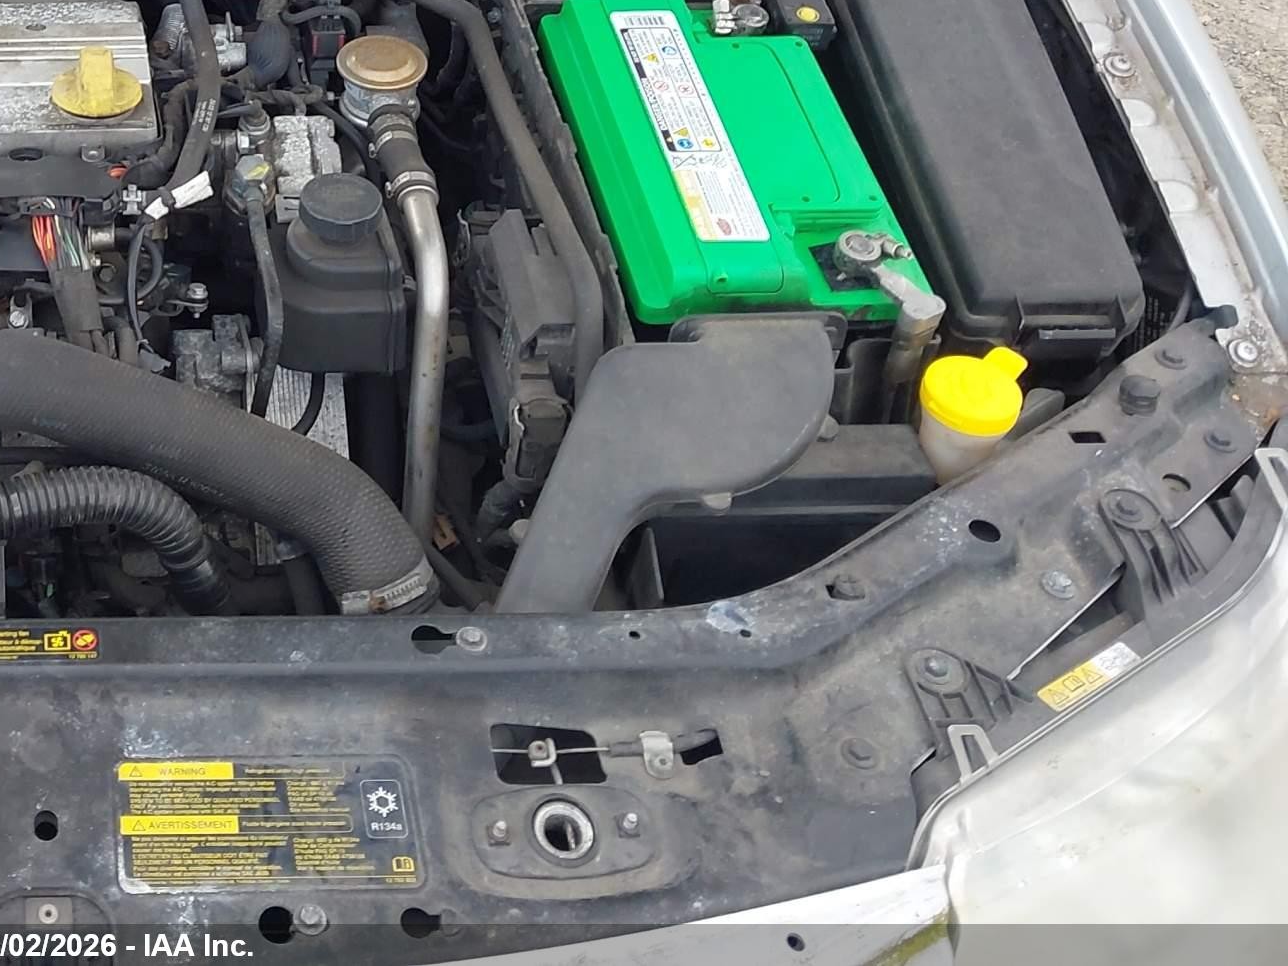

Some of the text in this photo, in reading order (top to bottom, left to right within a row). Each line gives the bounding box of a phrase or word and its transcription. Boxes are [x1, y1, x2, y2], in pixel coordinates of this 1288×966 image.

[159, 767, 206, 776] WARNING
[148, 820, 233, 830] AVERTISSEMENT
[371, 821, 403, 832] R134a
